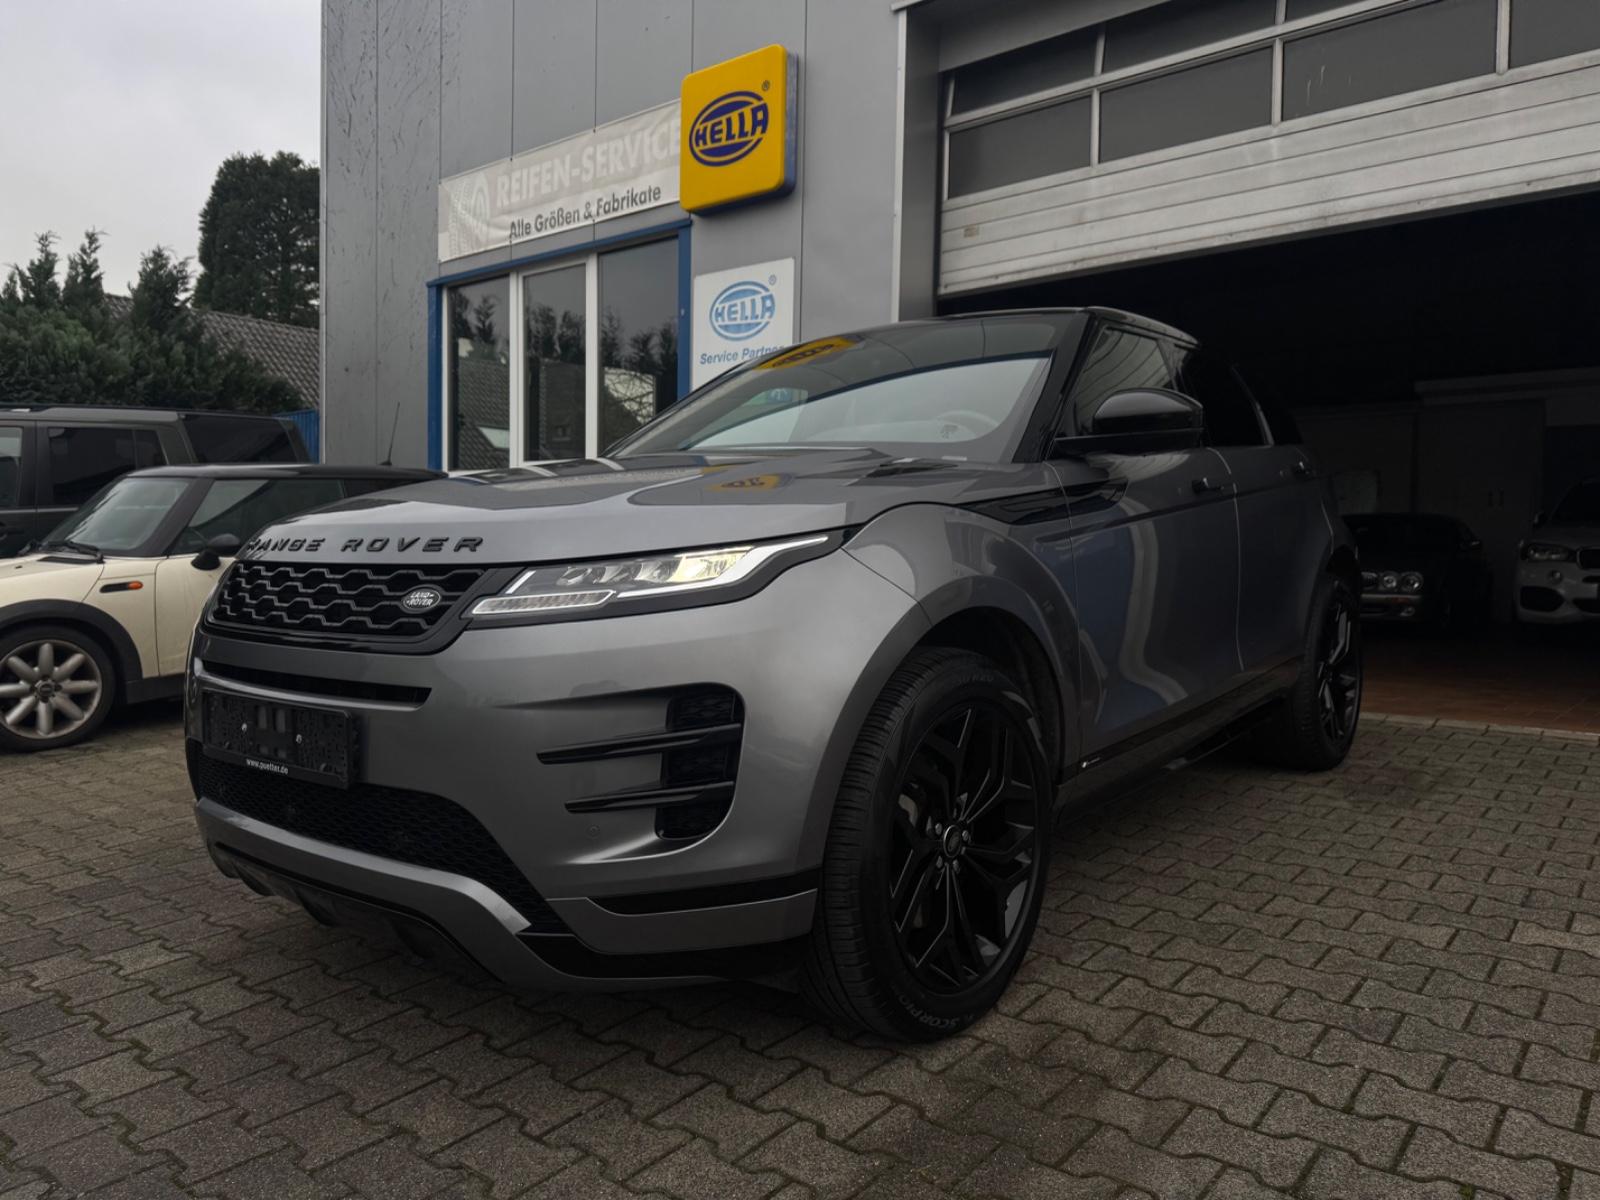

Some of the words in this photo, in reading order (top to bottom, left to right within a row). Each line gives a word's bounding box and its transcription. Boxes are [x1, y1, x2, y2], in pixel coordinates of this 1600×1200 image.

[694, 103, 769, 147] HELLA
[509, 220, 531, 239] Alle
[534, 207, 580, 232] Größen
[584, 200, 594, 219] &
[595, 185, 661, 216] Fabrikate
[714, 293, 775, 322] HELLA
[700, 350, 738, 365] Service
[341, 536, 483, 552] ROVER
